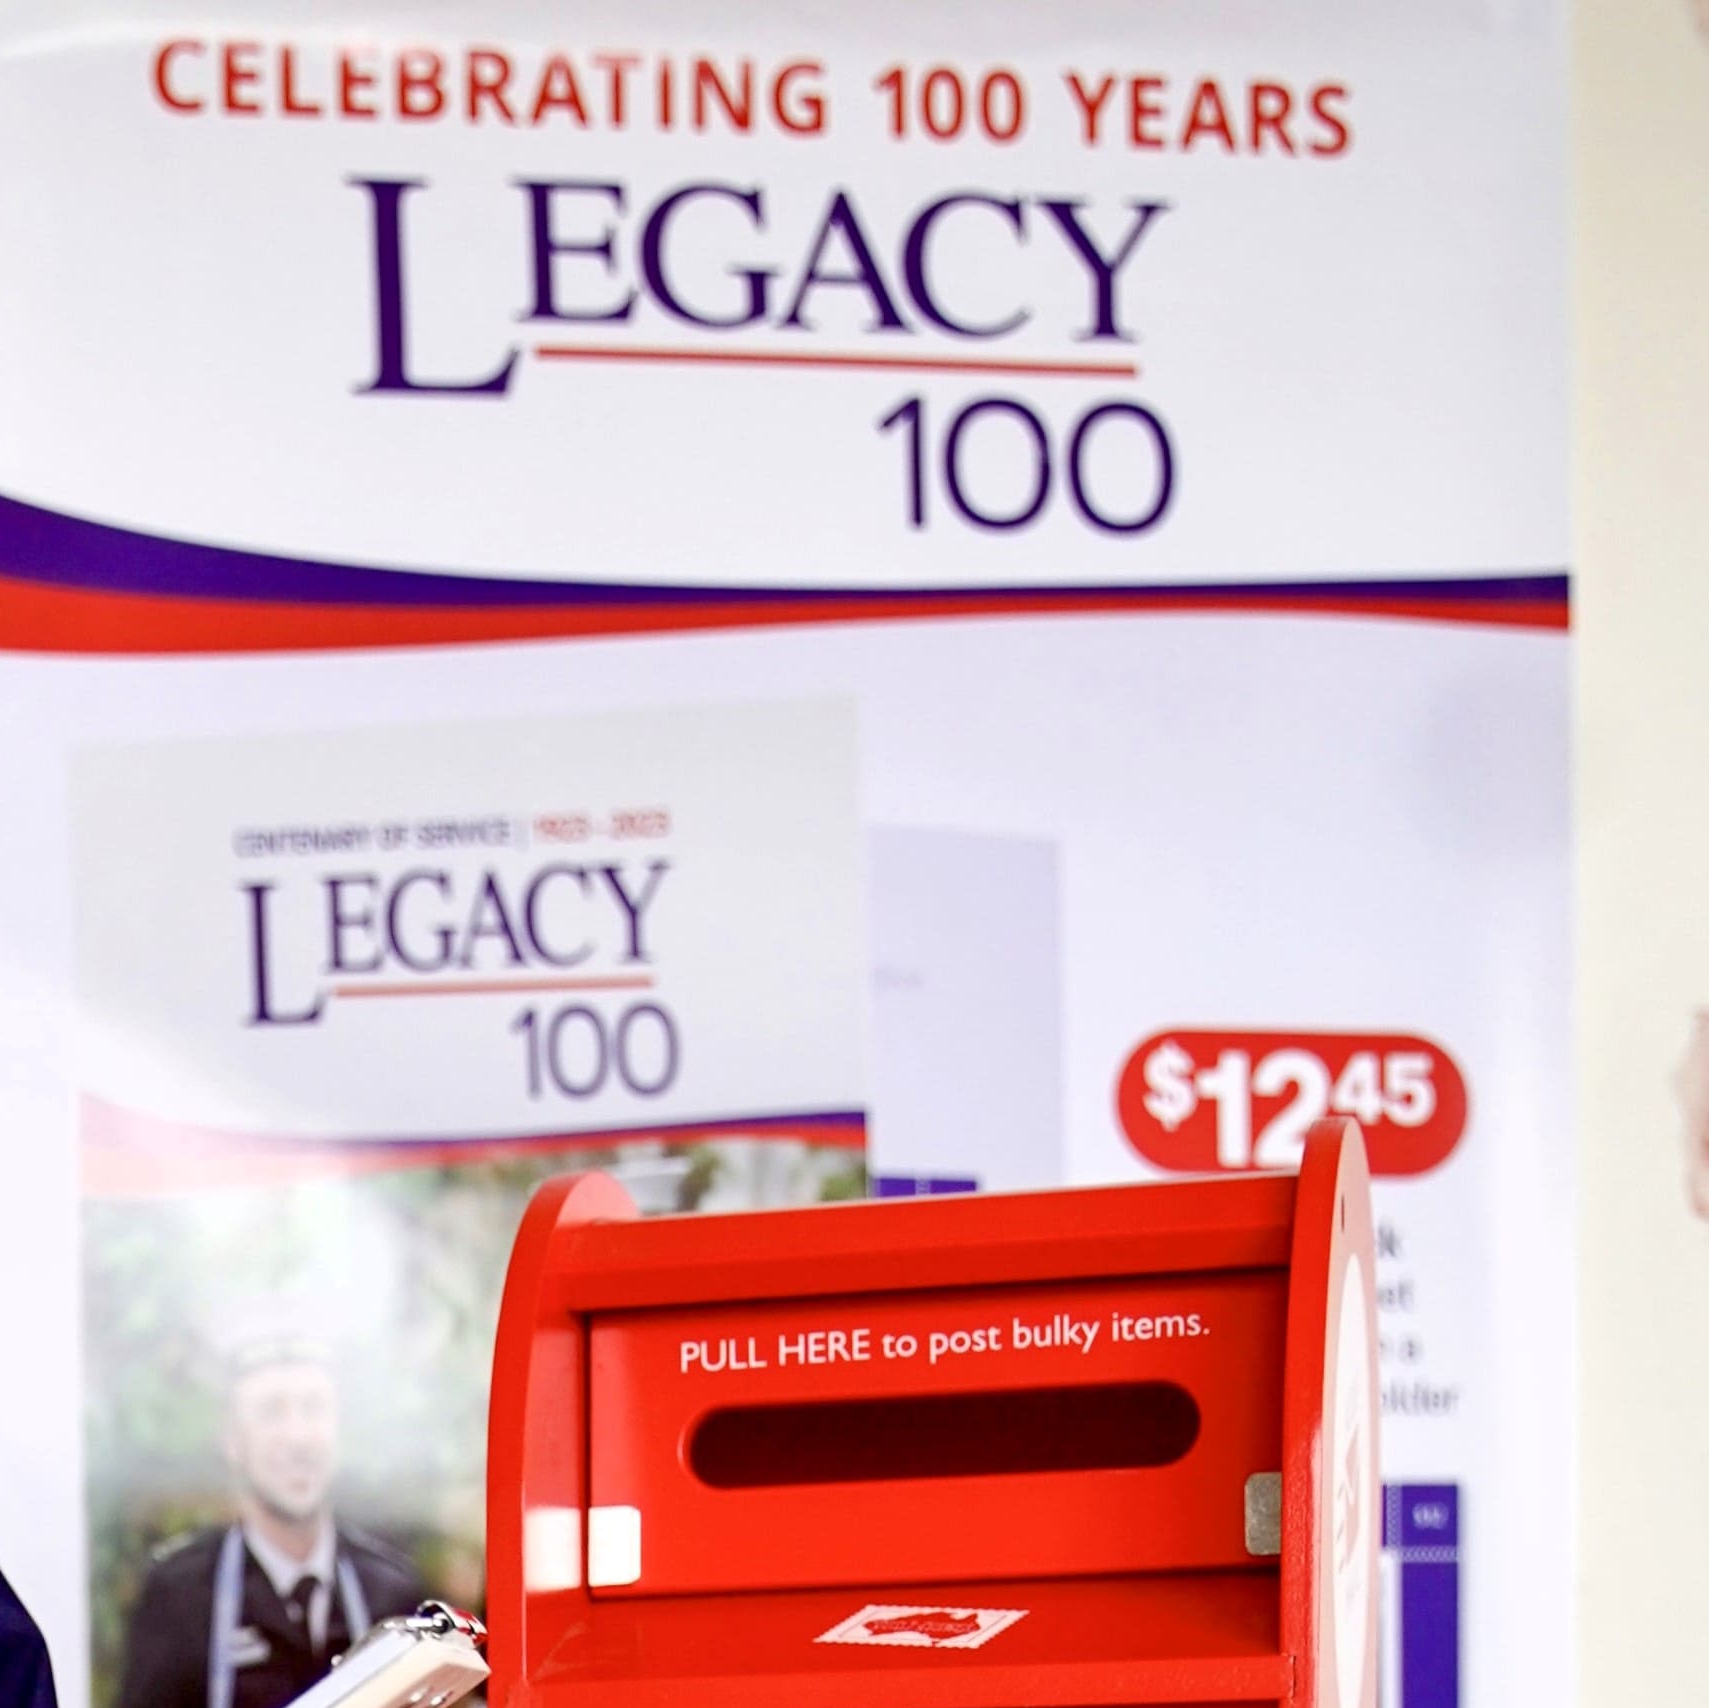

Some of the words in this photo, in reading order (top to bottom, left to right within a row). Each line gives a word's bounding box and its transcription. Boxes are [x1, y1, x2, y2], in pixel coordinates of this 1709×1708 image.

[152, 38, 830, 138] CELEBRATING
[872, 68, 1026, 143] 100
[1064, 72, 1353, 157] YEARS
[877, 395, 1176, 536] 100
[510, 1000, 682, 1101] 100
[681, 1337, 767, 1373] PULL
[778, 1328, 872, 1366] HERE
[882, 1331, 918, 1360] to
[928, 1323, 1002, 1364] post
[1012, 1313, 1100, 1354] bulky
[1111, 1311, 1210, 1344] items.
